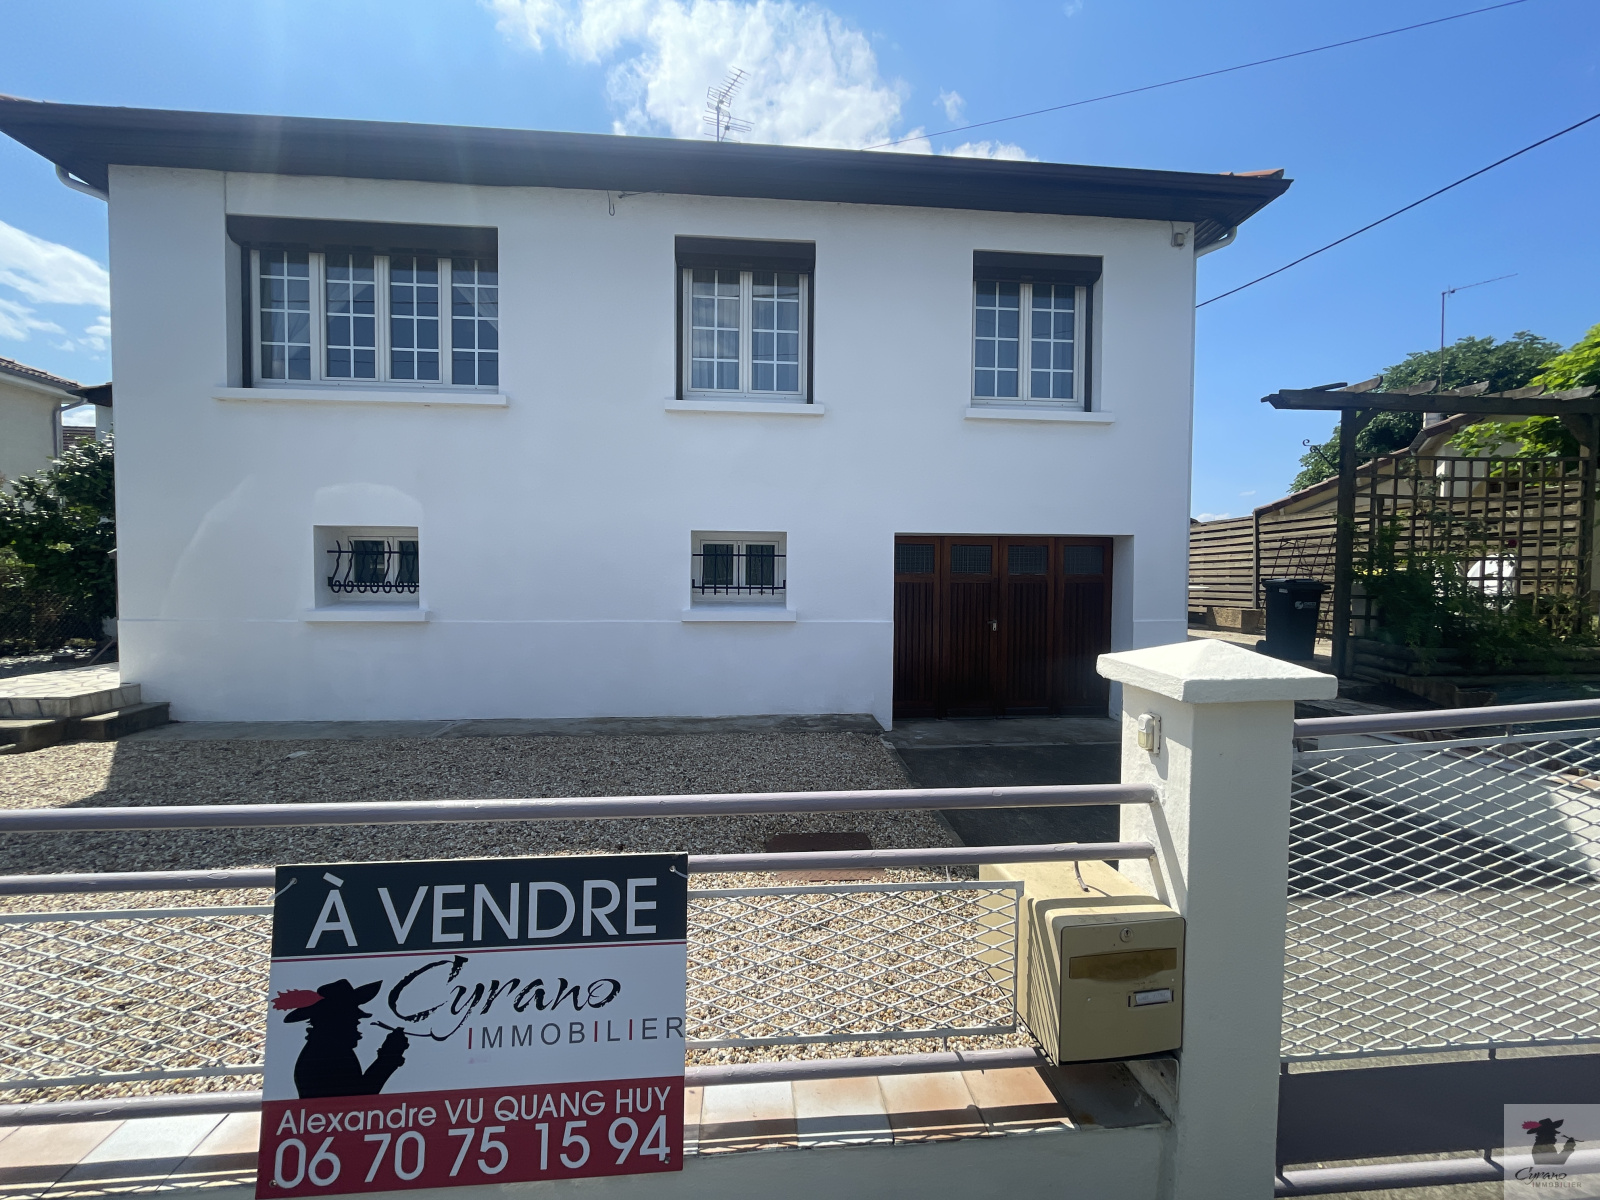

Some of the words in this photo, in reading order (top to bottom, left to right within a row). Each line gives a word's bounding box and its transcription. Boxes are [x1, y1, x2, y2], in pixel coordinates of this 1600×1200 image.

[305, 872, 359, 949] À
[377, 877, 657, 945] VENDRE
[388, 955, 621, 1041] Cyrano
[468, 1016, 685, 1050] IMMOBILIER
[276, 1101, 437, 1136] Alexandre
[444, 1097, 485, 1125] VU
[494, 1089, 606, 1123] QUANG
[615, 1086, 671, 1114] HUY
[274, 1136, 342, 1189] 06
[363, 1130, 426, 1183] 70
[448, 1126, 509, 1177] 75
[535, 1120, 591, 1171] 15
[608, 1114, 671, 1166] 94
